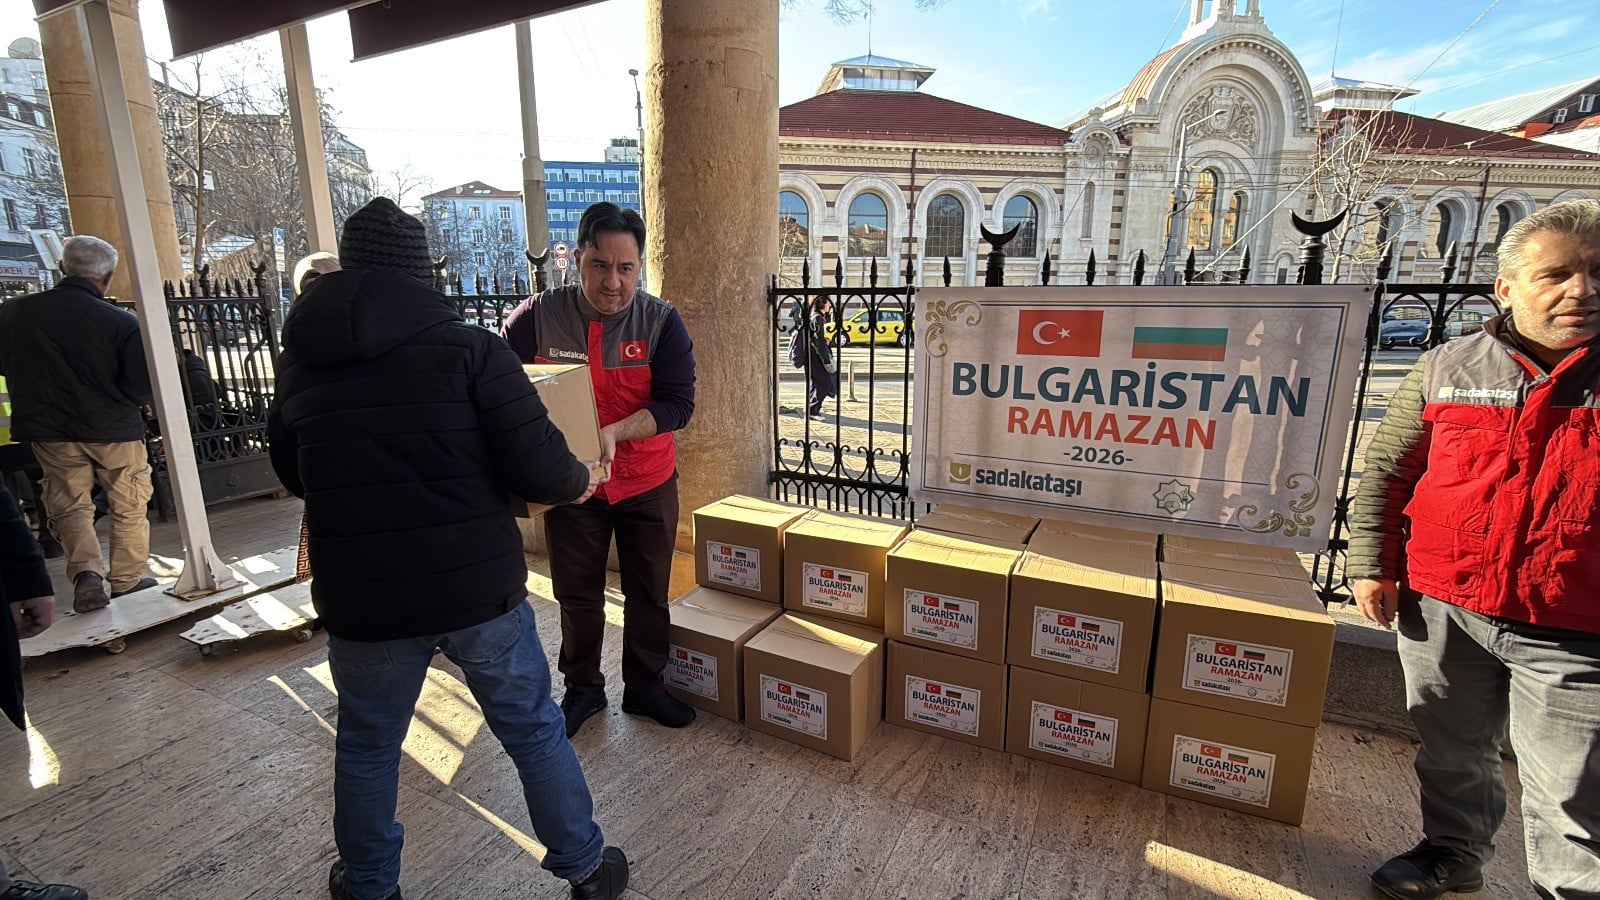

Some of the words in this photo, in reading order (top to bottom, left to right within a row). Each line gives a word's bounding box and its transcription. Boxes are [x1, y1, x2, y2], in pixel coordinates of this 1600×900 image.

[952, 361, 1311, 417] BULGARİSTAN
[1007, 405, 1217, 450] RAMAZAN
[1063, 446, 1133, 466] -2026-
[975, 466, 1082, 497] sadakataşı
[819, 587, 852, 598] RAMAZAN
[922, 615, 960, 629] RAMAZAN
[1054, 636, 1099, 651] RAMAZAN
[1196, 652, 1283, 676] BULGARİSTAN
[1210, 666, 1263, 682] RAMAZAN
[777, 702, 811, 718] RAMAZAN
[924, 702, 961, 716] RAMAZAN
[1051, 730, 1095, 746] RAMAZAN
[1182, 753, 1266, 779] BULGARİSTAN
[1196, 766, 1247, 783] RAMAZAN
